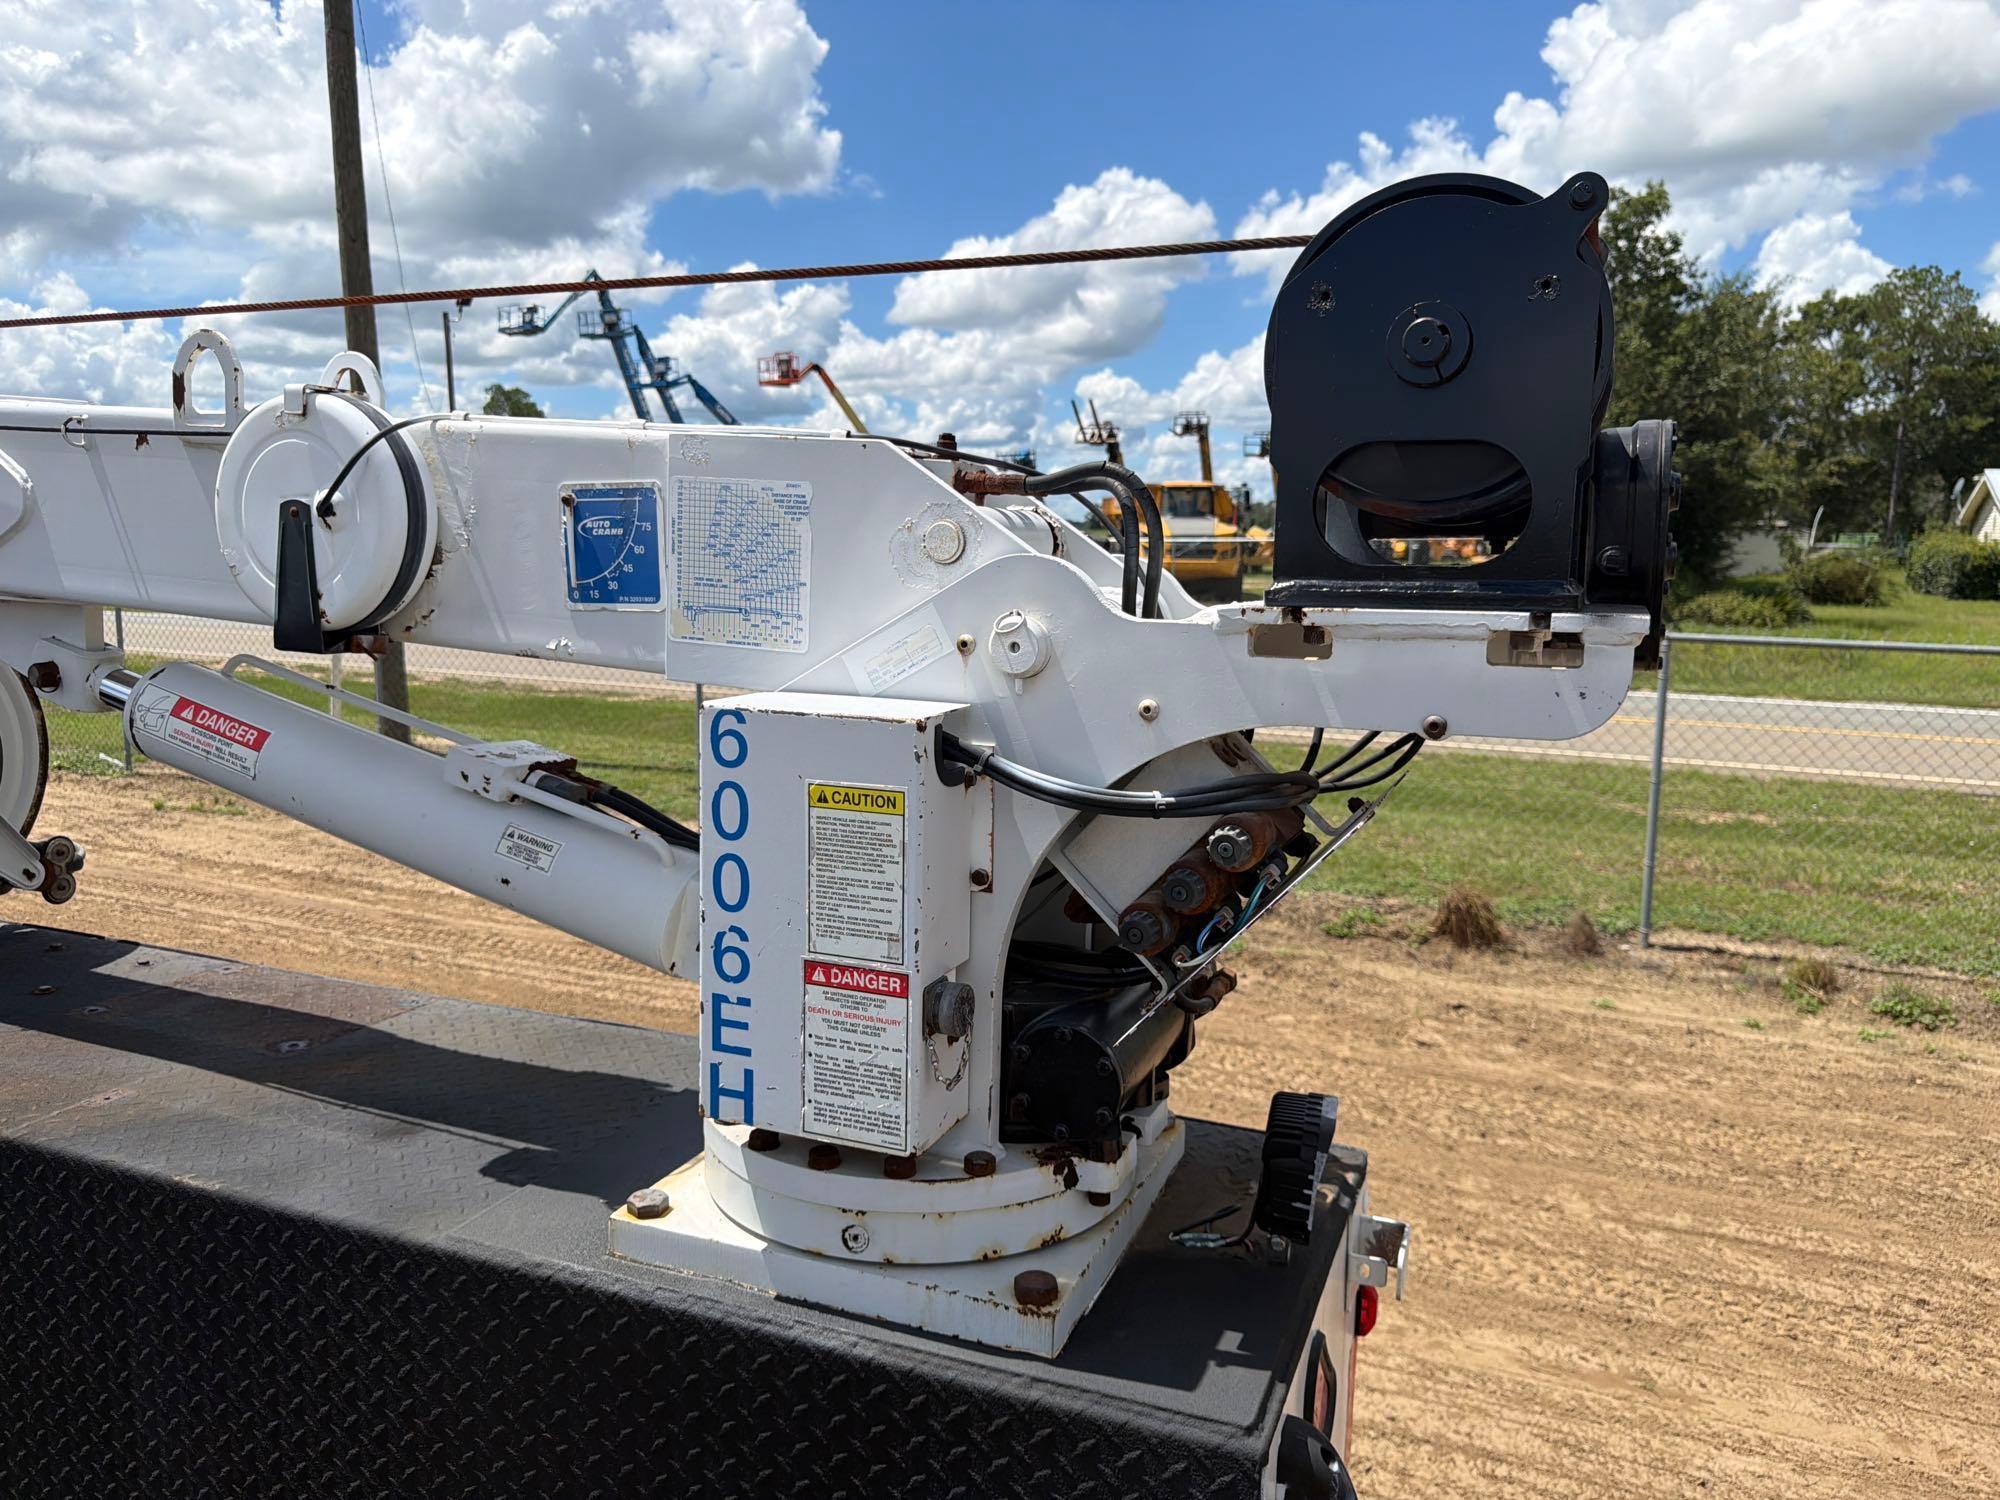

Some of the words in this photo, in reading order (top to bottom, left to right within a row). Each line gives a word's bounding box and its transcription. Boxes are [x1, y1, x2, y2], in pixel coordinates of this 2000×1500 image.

[585, 520, 610, 528] AUTO
[641, 522, 651, 531] 75
[634, 545, 645, 554] 60
[622, 564, 634, 573] 45
[608, 581, 618, 590] 30
[573, 591, 579, 599] 0
[589, 590, 600, 599] 15
[195, 709, 258, 746] DANGER
[190, 726, 217, 742] SCISSORS
[217, 738, 233, 749] POINT
[173, 727, 196, 742] SERIOUS
[195, 737, 214, 750] INJURY
[214, 745, 228, 756] WILL
[227, 751, 247, 764] RESULT
[831, 791, 897, 810] CAUTION
[517, 833, 554, 852] WARNING
[830, 969, 900, 993] DANGER
[830, 991, 858, 999] UNTRAINED
[824, 996, 849, 1004] SUBJECTS
[808, 1006, 830, 1015] DEATH
[844, 1011, 873, 1022] SERIOUS
[876, 1016, 901, 1026] INJURY
[840, 1026, 858, 1034] CRANE
[862, 1024, 886, 1032] OPERATE
[814, 1040, 837, 1049] operation
[859, 1061, 889, 1070] understand,
[814, 1065, 858, 1076] recommendations
[860, 1073, 885, 1081] contained
[877, 1070, 902, 1078] operating
